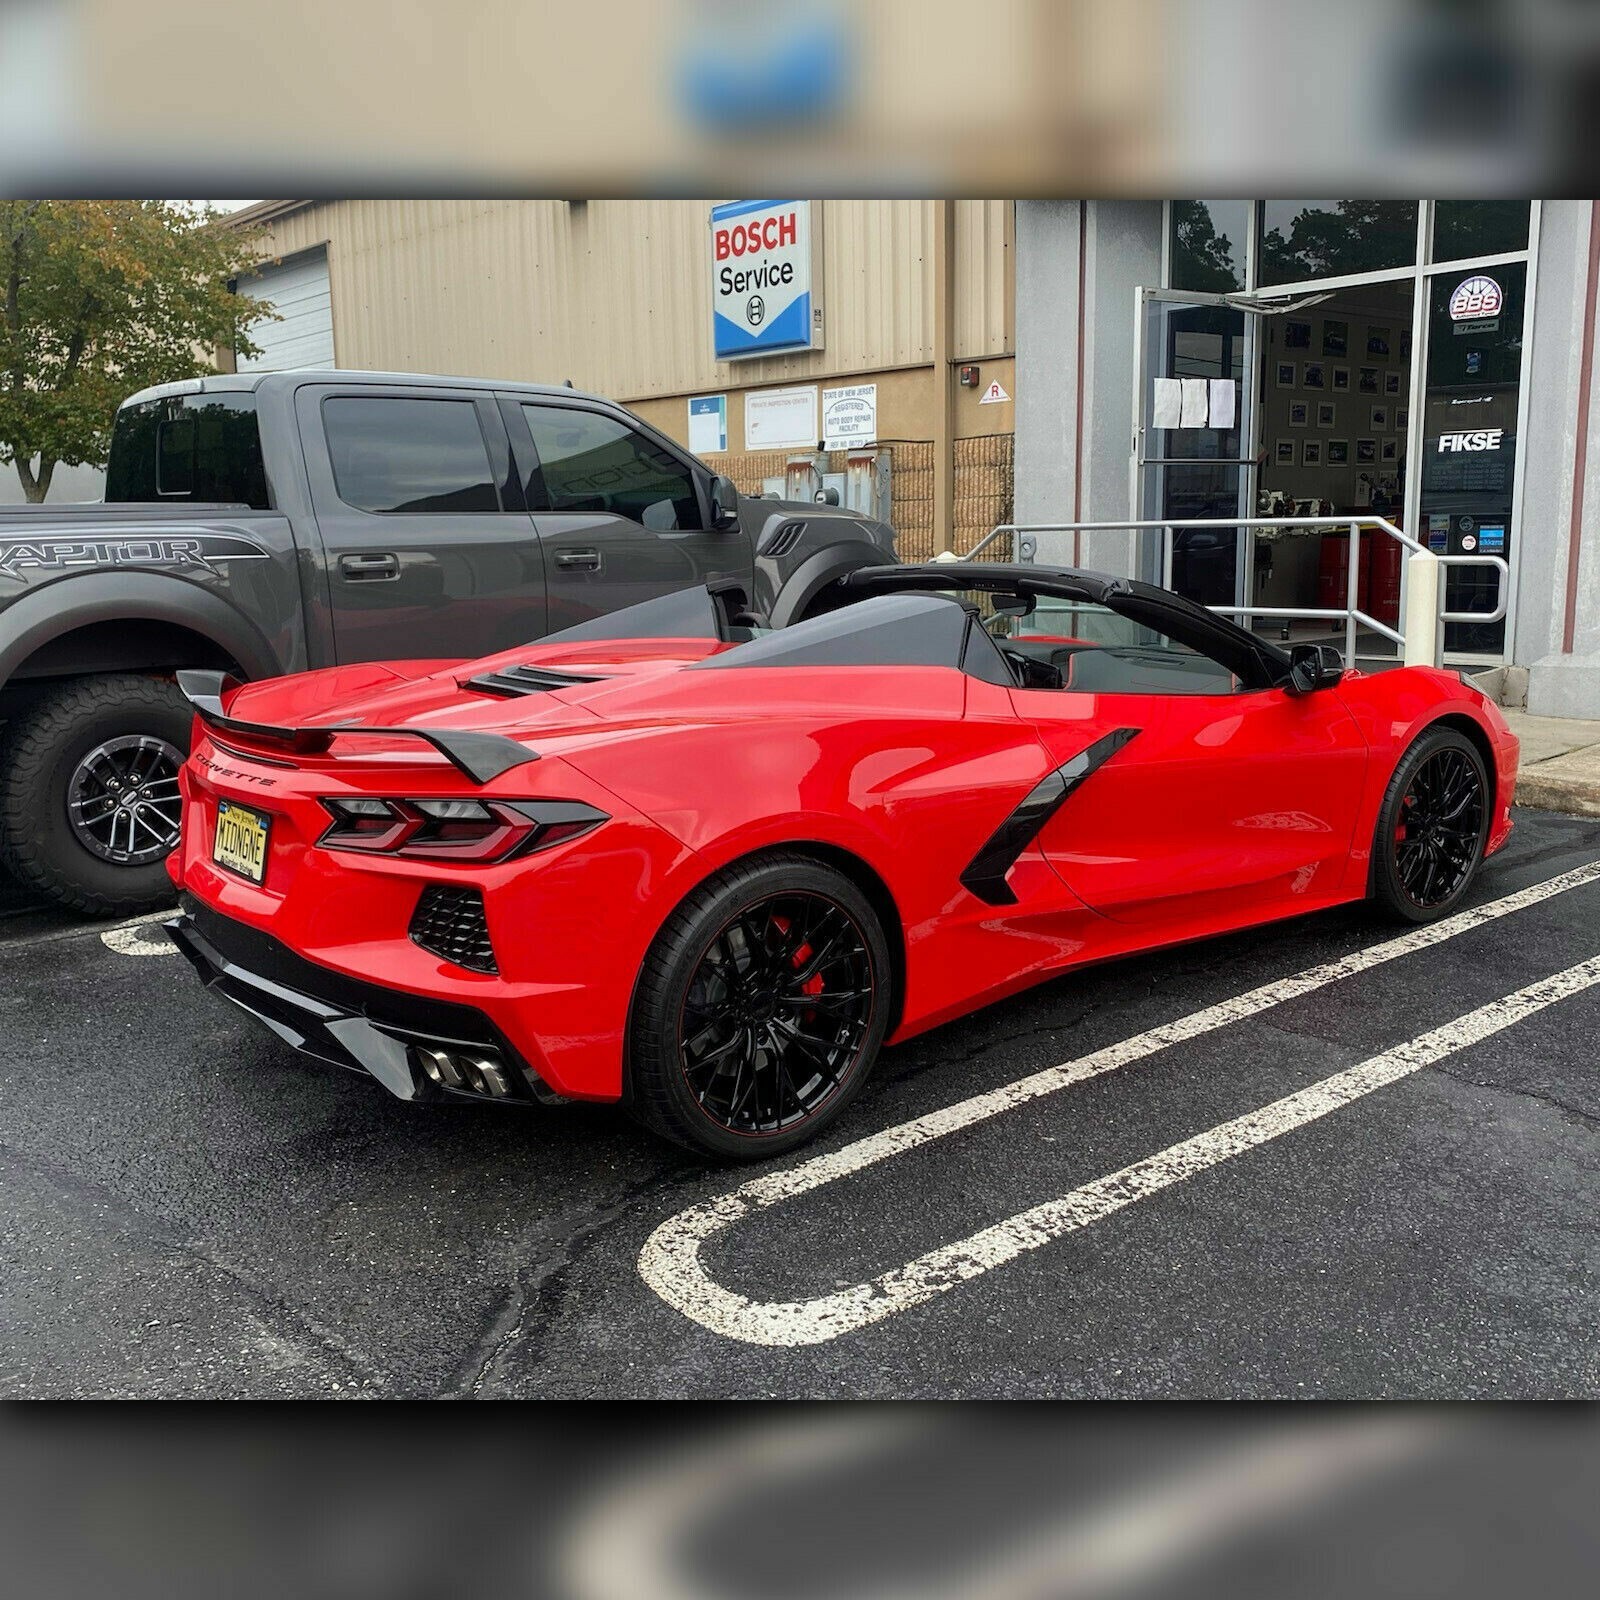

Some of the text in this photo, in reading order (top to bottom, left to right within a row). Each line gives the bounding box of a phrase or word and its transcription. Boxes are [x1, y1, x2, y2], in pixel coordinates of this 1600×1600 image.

[715, 213, 797, 261] BOSCH
[720, 260, 793, 296] Service
[1453, 294, 1498, 312] BBS
[824, 386, 875, 400] STATE OF NEW JERSEY
[991, 385, 999, 397] R
[828, 414, 871, 425] AUTO BODY REPAIR
[1438, 431, 1503, 453] FIKSE
[0, 540, 216, 575] APTOR
[196, 753, 277, 787] CORVETTE
